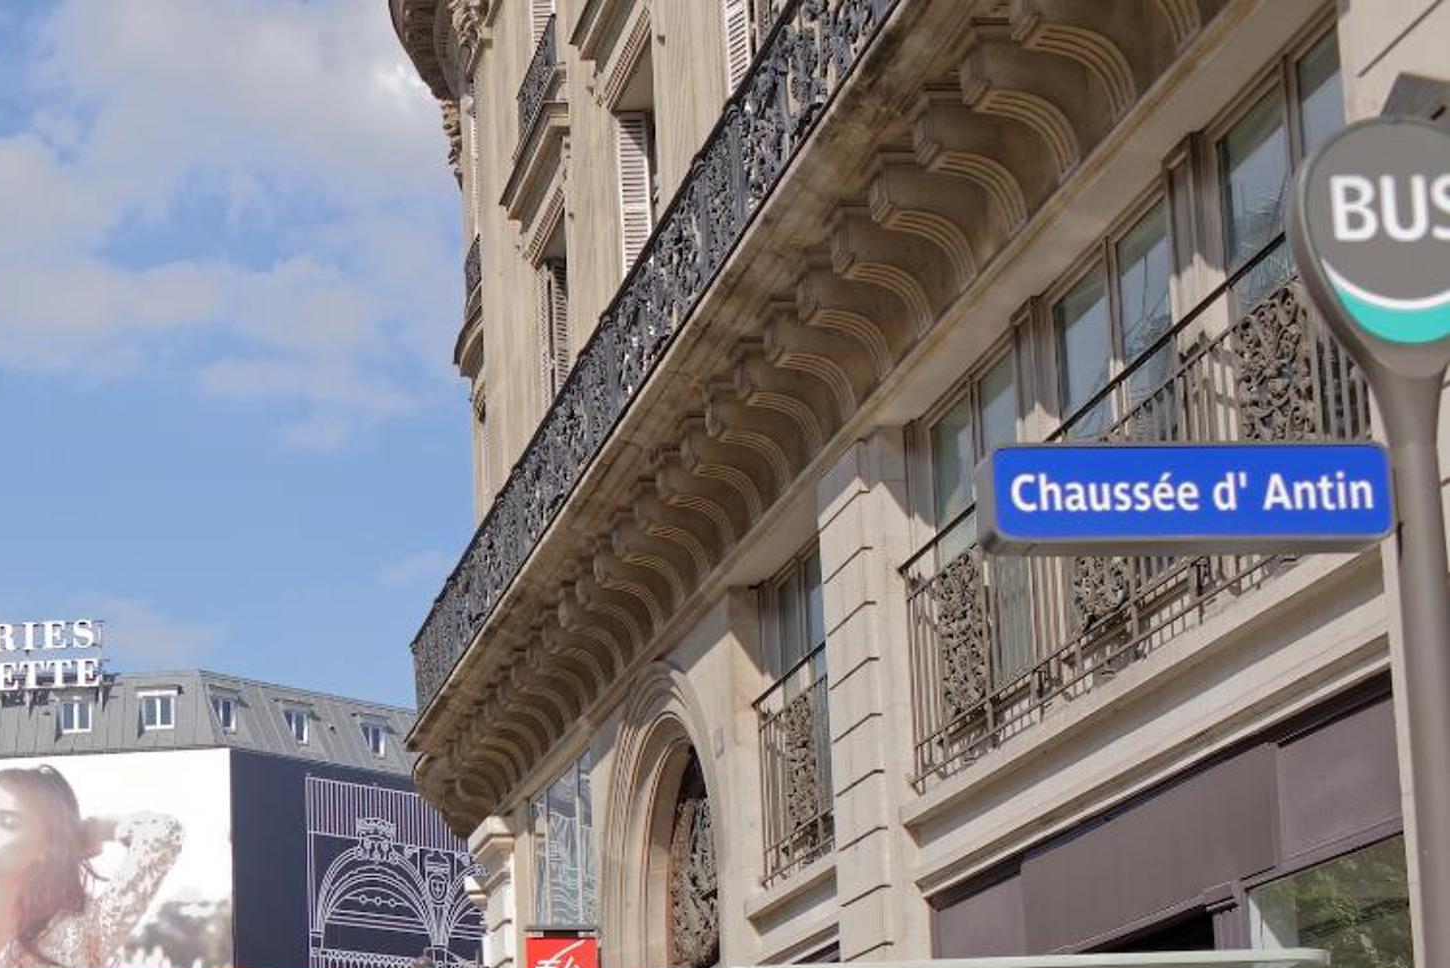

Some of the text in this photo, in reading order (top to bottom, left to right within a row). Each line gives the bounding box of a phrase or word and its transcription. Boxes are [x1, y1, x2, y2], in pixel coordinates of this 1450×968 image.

[1010, 471, 1375, 513] Chaussée d' Antin
